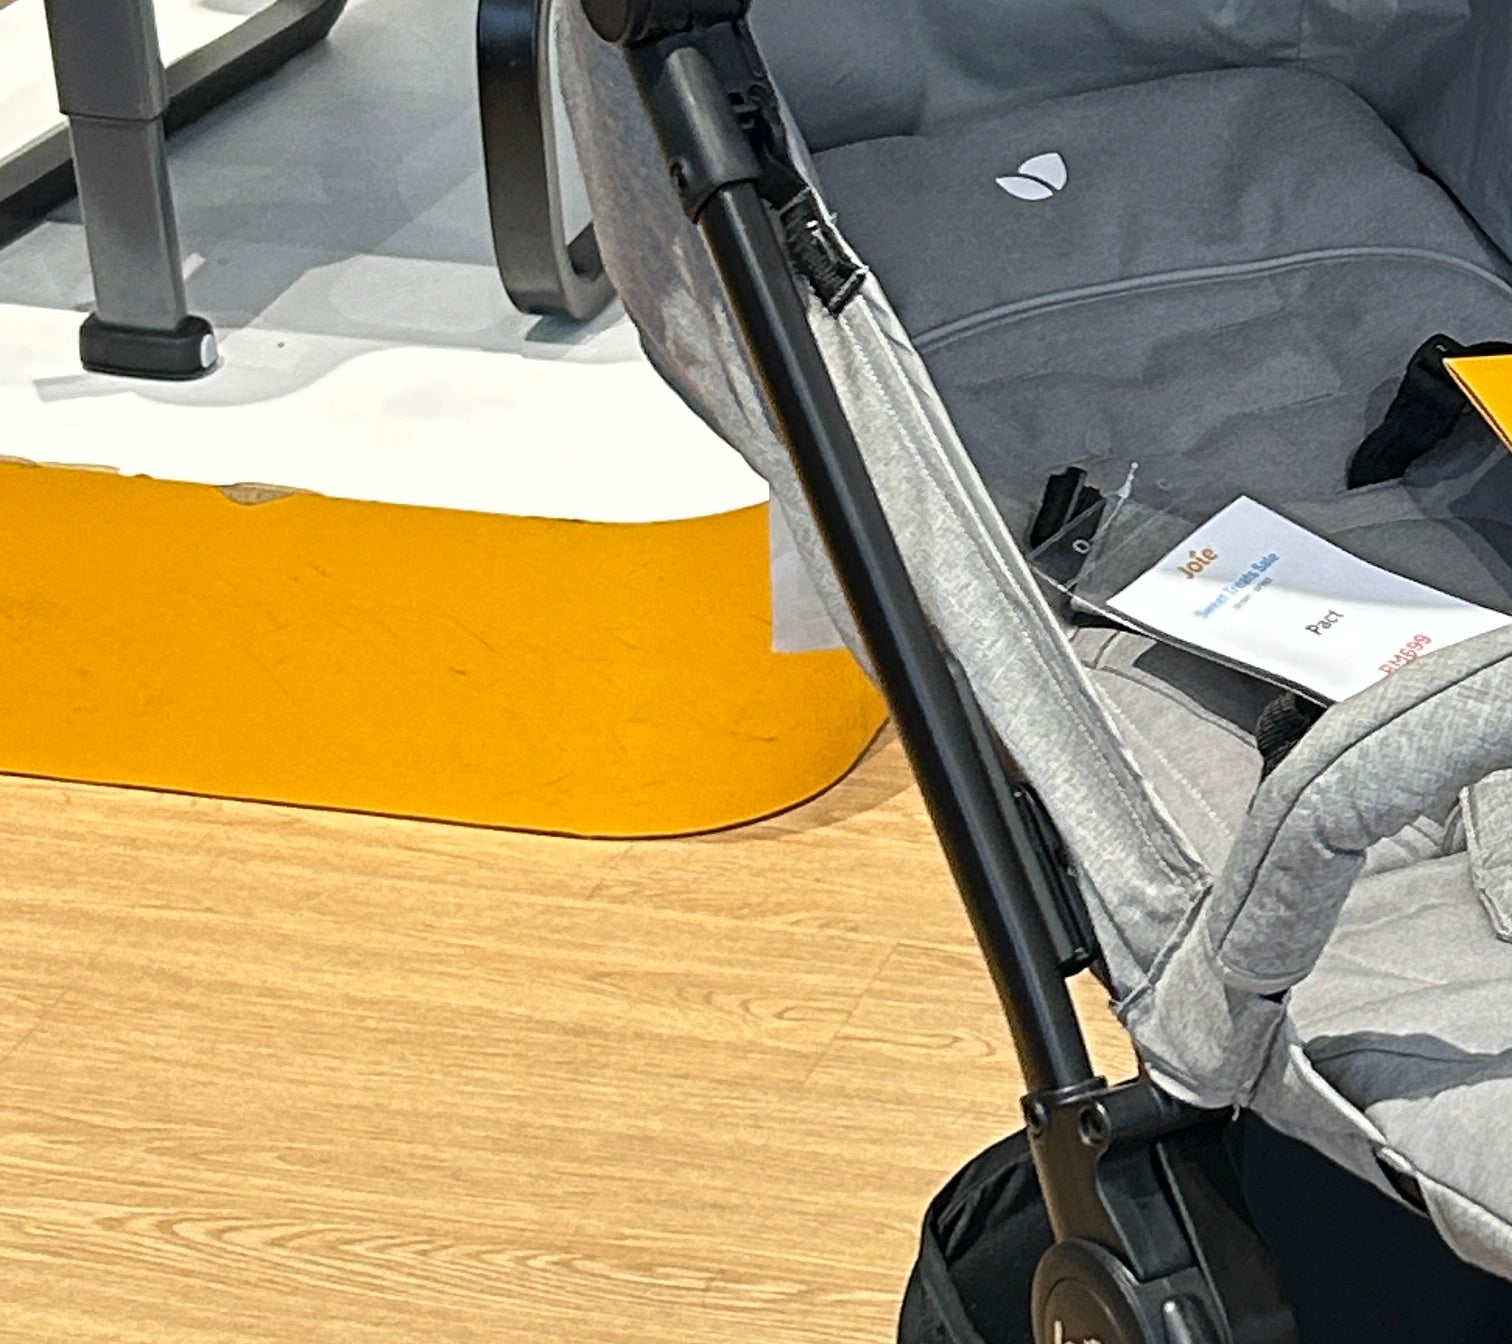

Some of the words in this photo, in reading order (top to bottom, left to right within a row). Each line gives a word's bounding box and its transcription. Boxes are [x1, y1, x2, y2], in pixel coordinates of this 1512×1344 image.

[1177, 546, 1218, 579] Joie
[1251, 553, 1279, 573] Sale
[1305, 609, 1344, 635] Pact
[1378, 634, 1431, 674] RM699
